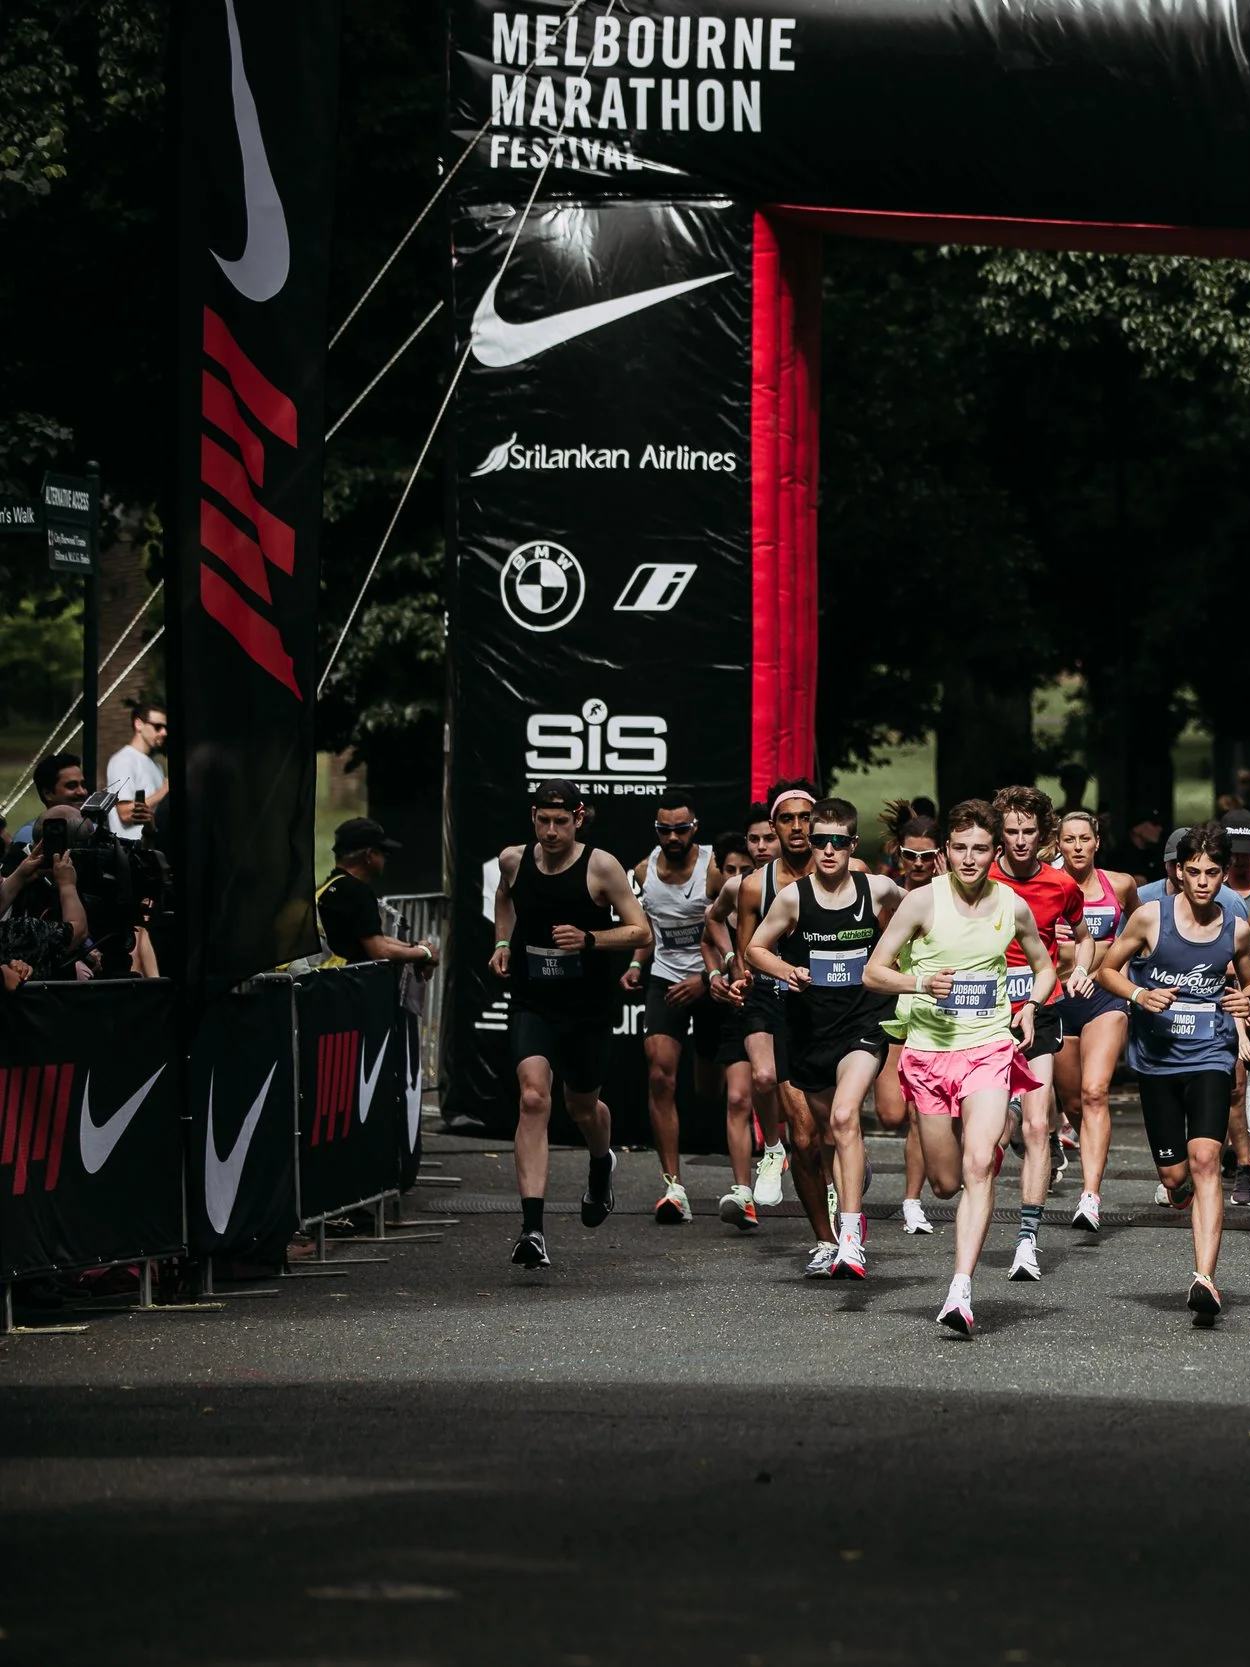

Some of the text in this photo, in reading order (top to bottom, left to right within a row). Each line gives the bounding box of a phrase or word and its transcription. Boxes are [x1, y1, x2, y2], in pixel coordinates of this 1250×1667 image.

[493, 13, 796, 71] MELBOURNE
[490, 73, 762, 132] MARATHON
[489, 135, 642, 172] FESTIVAL
[510, 443, 737, 472] SriLankan Airlines
[13, 506, 35, 523] Walk
[513, 546, 573, 572] BMW
[594, 784, 609, 795] IN
[613, 784, 667, 796] SPORT
[802, 929, 872, 942] UpThere Athletics
[545, 958, 558, 967] TEZ
[833, 962, 846, 973] NIC
[827, 972, 851, 982] 60231
[1189, 985, 1214, 995] Pack
[955, 995, 980, 1005] 60189
[1173, 1013, 1196, 1024] JIMBO
[1170, 1024, 1196, 1035] 60047
